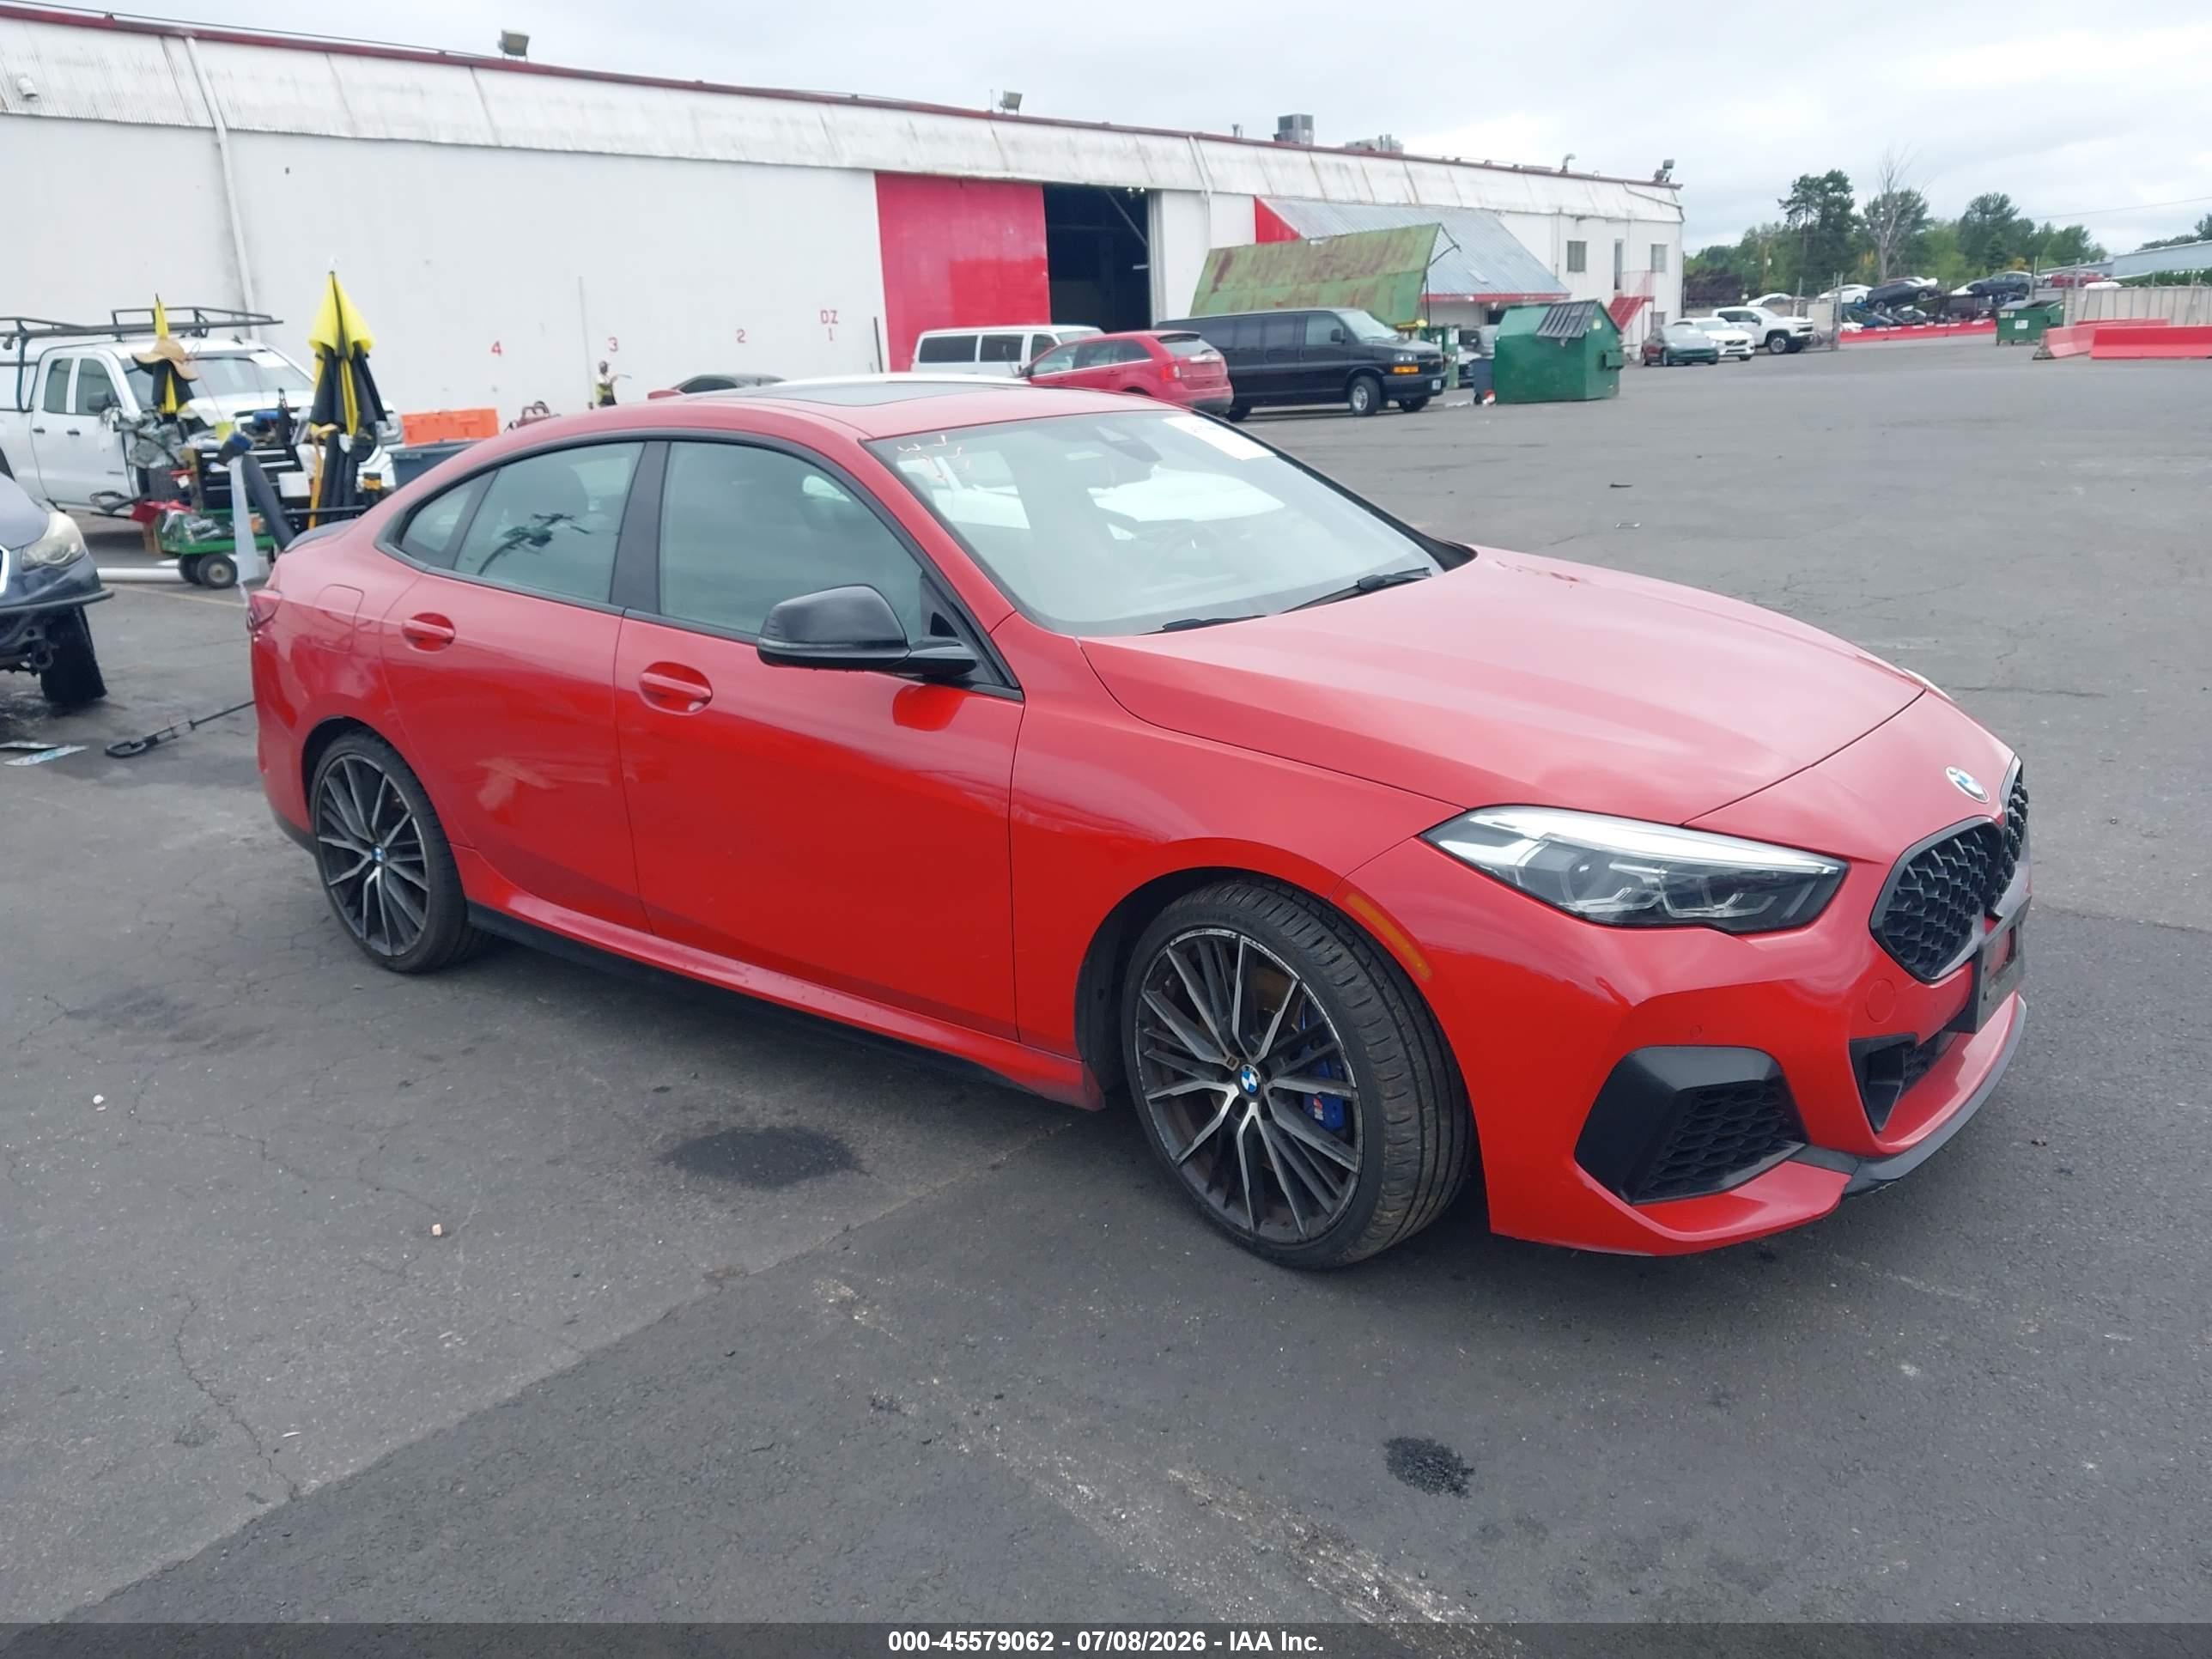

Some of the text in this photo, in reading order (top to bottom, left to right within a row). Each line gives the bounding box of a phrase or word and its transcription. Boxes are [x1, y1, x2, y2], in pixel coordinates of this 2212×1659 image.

[607, 336, 619, 353] 3
[736, 328, 747, 344] 2
[490, 340, 502, 357] 4
